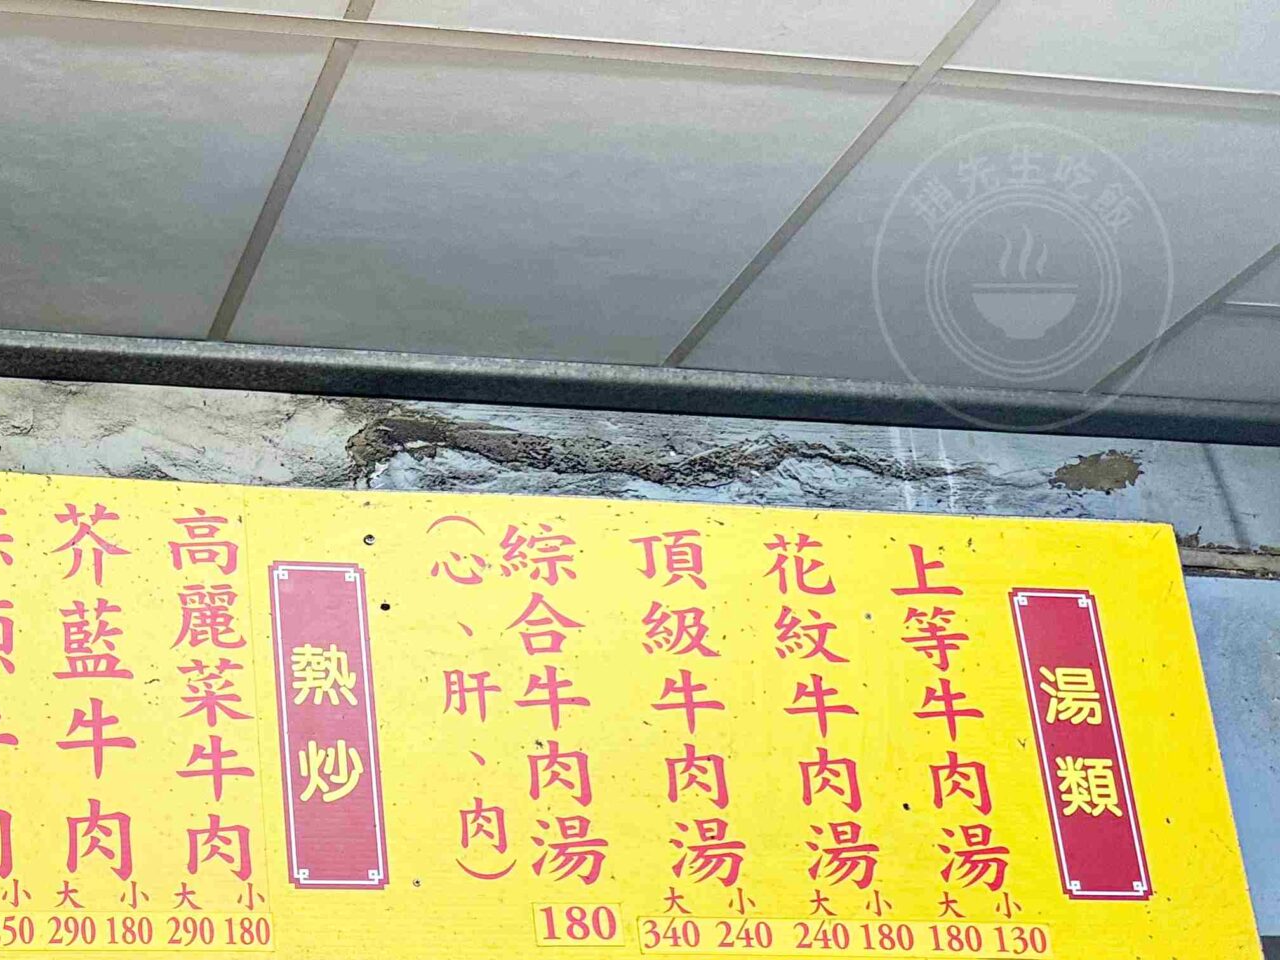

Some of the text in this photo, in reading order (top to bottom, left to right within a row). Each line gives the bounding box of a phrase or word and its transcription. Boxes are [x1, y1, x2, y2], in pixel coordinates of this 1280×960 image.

[52, 504, 136, 880] 芥藍牛肉
[168, 508, 255, 881] 高麗菜牛肉
[501, 525, 608, 885] 綜合牛肉湯
[290, 642, 364, 803] 熱炒
[631, 529, 746, 888] 頂級牛肉湯
[764, 533, 880, 889] 花紋牛肉湯
[891, 544, 1009, 892] 上等牛肉湯
[1039, 665, 1122, 817] 湯類
[3, 879, 31, 908] 小
[56, 880, 149, 910] 大 小
[173, 883, 265, 911] 大 小
[664, 888, 755, 914] 大 小
[810, 889, 892, 917] 大 小
[939, 892, 1020, 918] 大 小
[48, 916, 152, 944] 290 180
[167, 917, 270, 944] 290 180
[543, 906, 616, 940] 180
[645, 920, 773, 948] 340 240
[796, 922, 914, 951] 240 180
[931, 925, 1047, 953] 180 130
